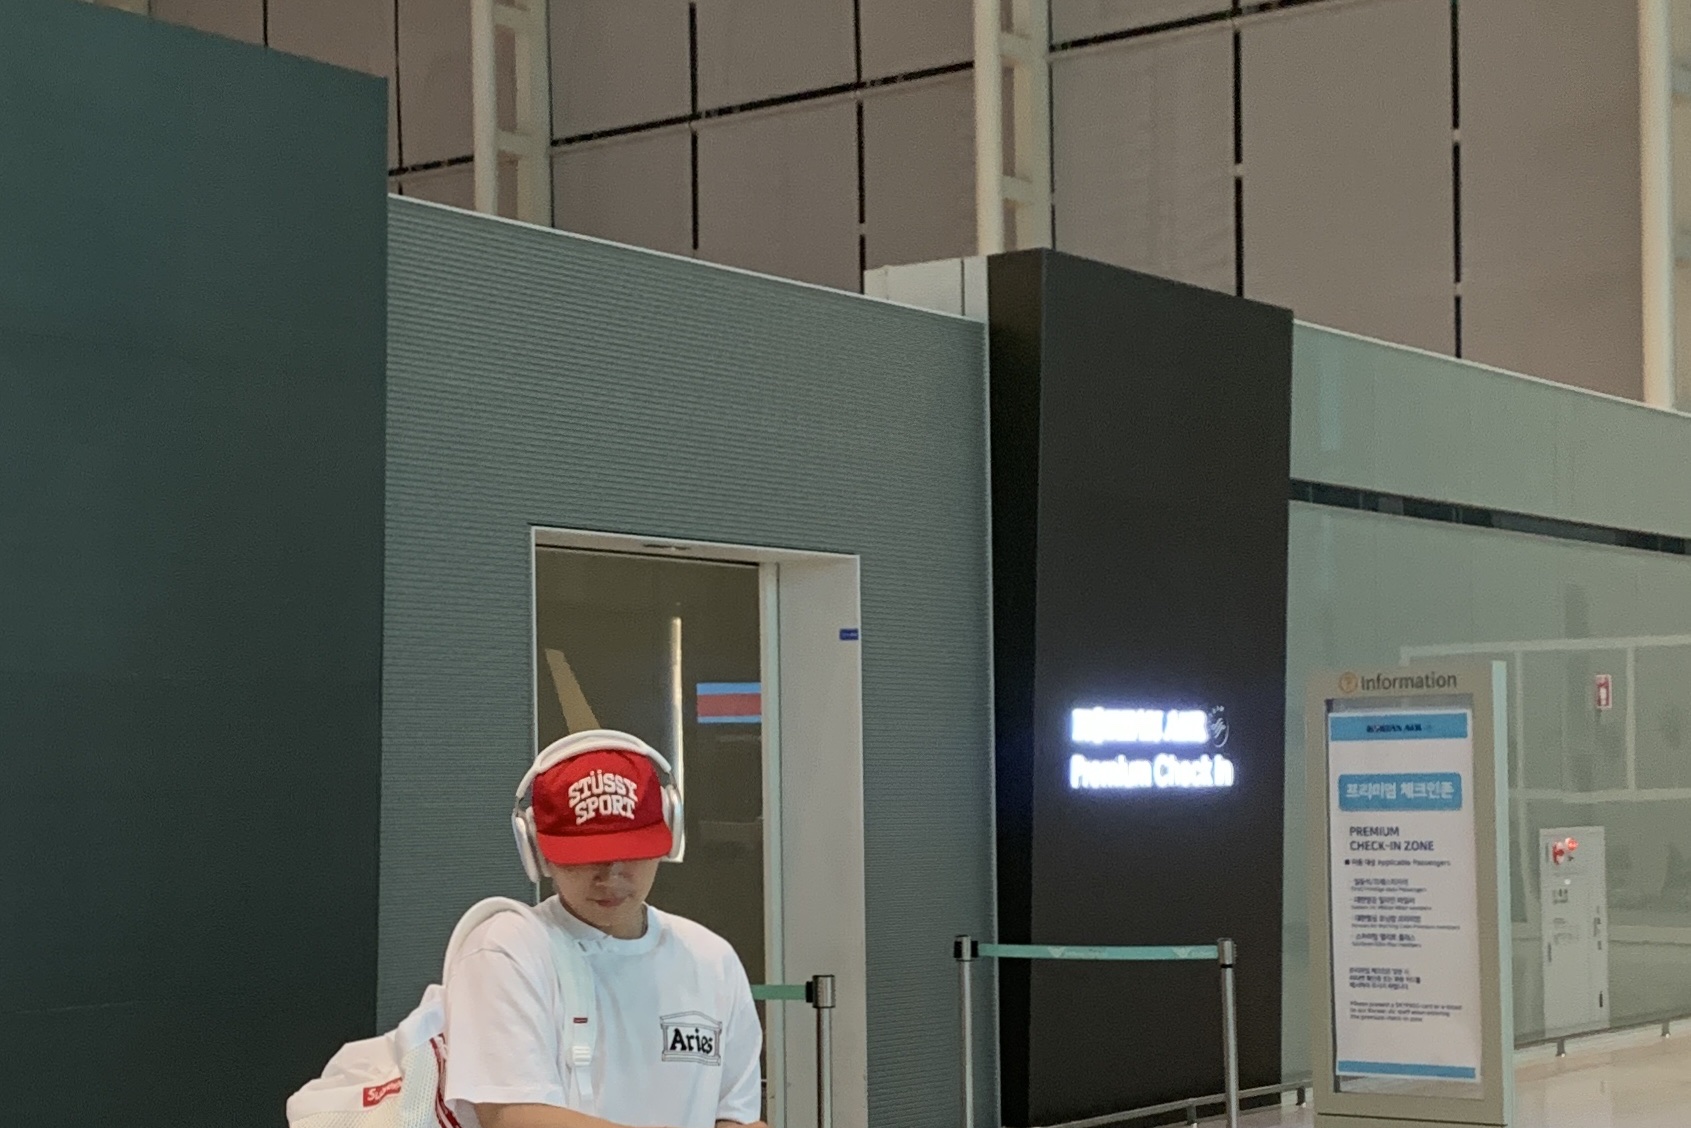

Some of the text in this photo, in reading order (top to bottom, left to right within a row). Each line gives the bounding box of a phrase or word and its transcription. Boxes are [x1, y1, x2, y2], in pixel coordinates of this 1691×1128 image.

[1361, 671, 1457, 691] Information
[1154, 753, 1213, 788] Check
[568, 769, 638, 808] STÜSSY
[1345, 781, 1454, 800] 프리미엄 체크인존
[575, 795, 635, 826] SPORT
[1349, 826, 1400, 837] PREMIUM
[1349, 841, 1434, 851] CHECK-IN ZONE
[669, 1027, 713, 1054] Aries
